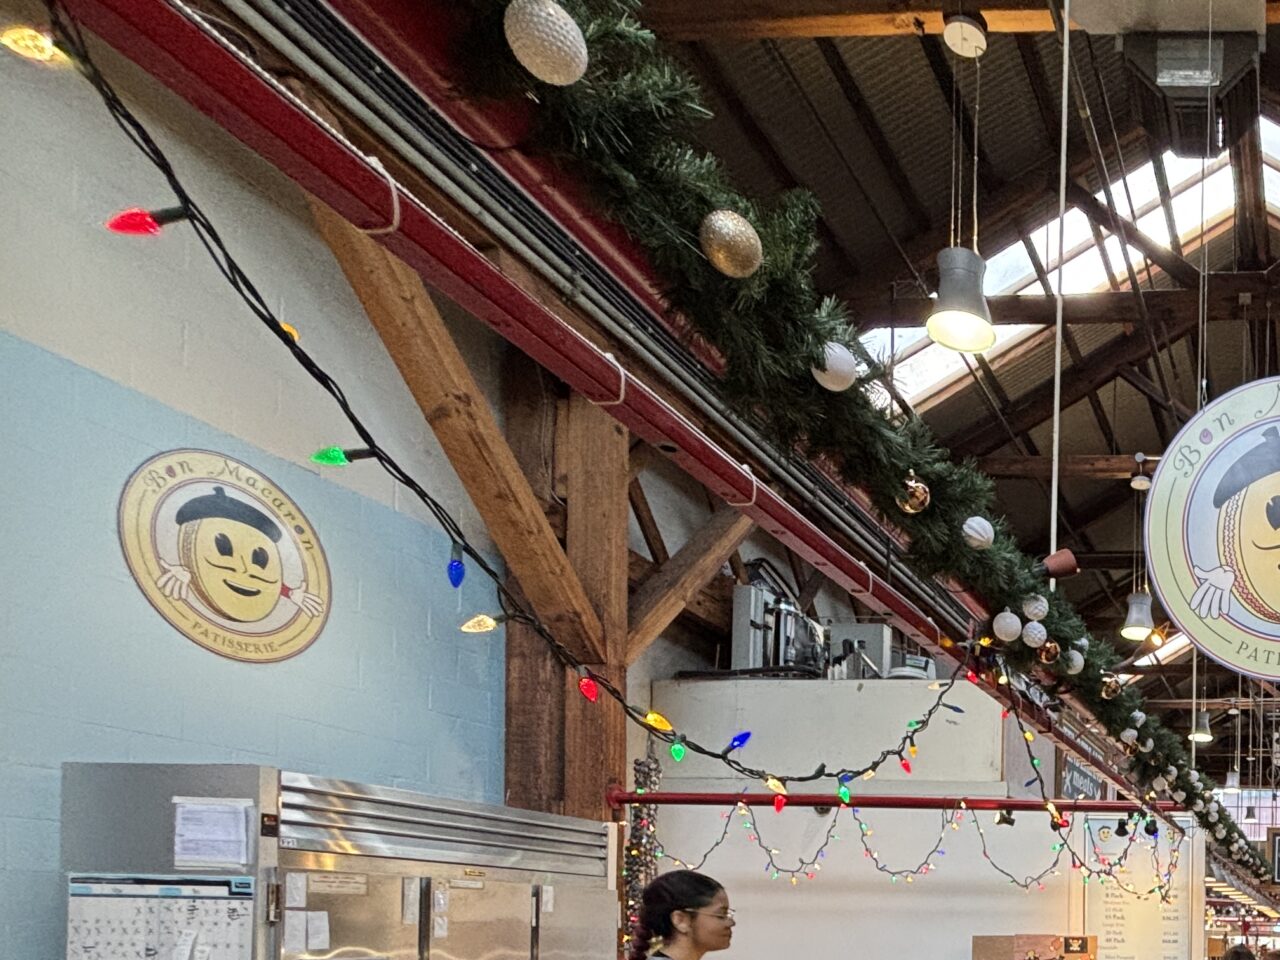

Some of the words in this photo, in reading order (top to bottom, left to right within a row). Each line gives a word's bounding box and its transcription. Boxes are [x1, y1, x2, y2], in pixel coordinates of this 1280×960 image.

[1172, 410, 1235, 478] Bon
[144, 460, 194, 494] Bon
[208, 460, 315, 551] Macaron
[191, 620, 278, 655] PATISSERIE
